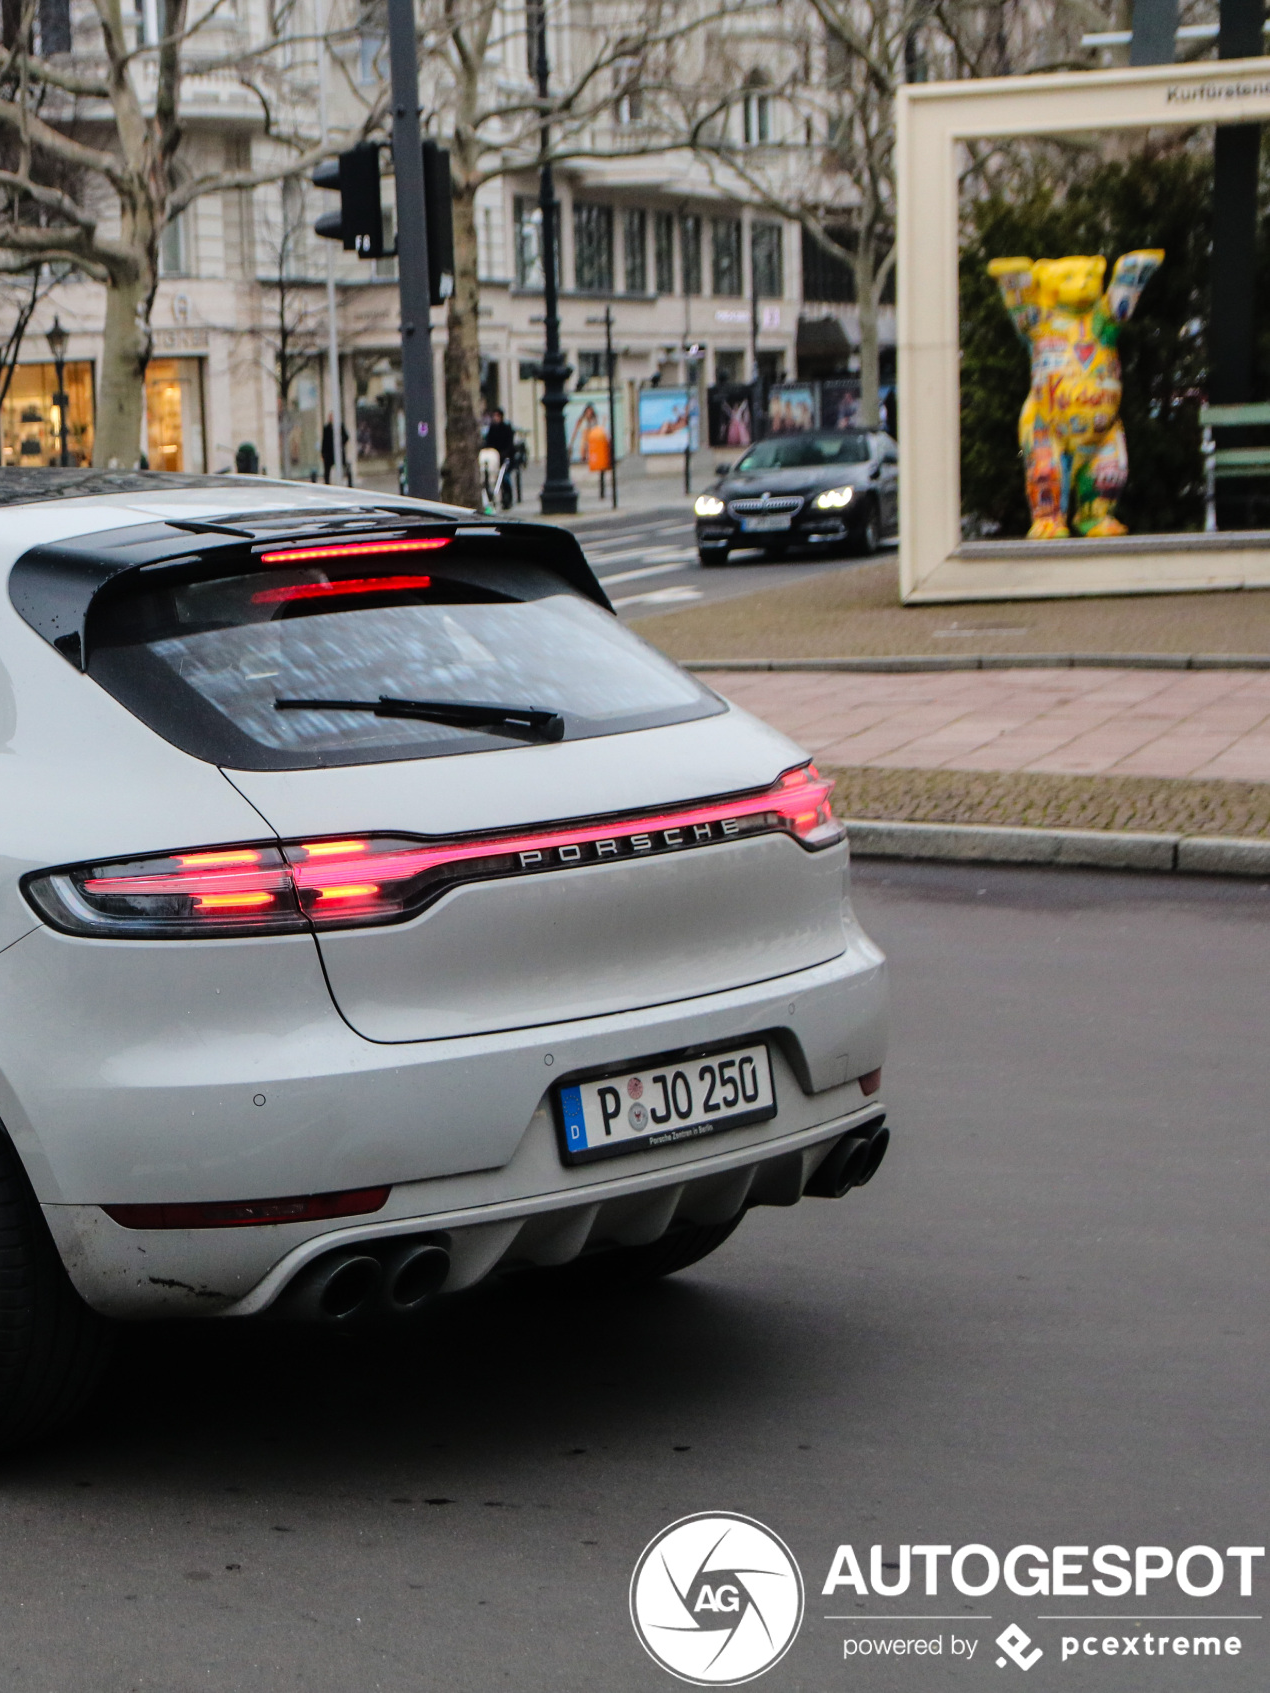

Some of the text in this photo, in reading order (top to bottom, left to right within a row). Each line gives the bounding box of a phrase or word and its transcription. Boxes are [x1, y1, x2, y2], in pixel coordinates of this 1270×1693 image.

[519, 818, 739, 867] PORSCHE
[597, 1056, 759, 1136] P JO 250
[570, 1125, 580, 1140] D
[649, 1134, 672, 1145] Porsche
[698, 1124, 714, 1134] Berlin
